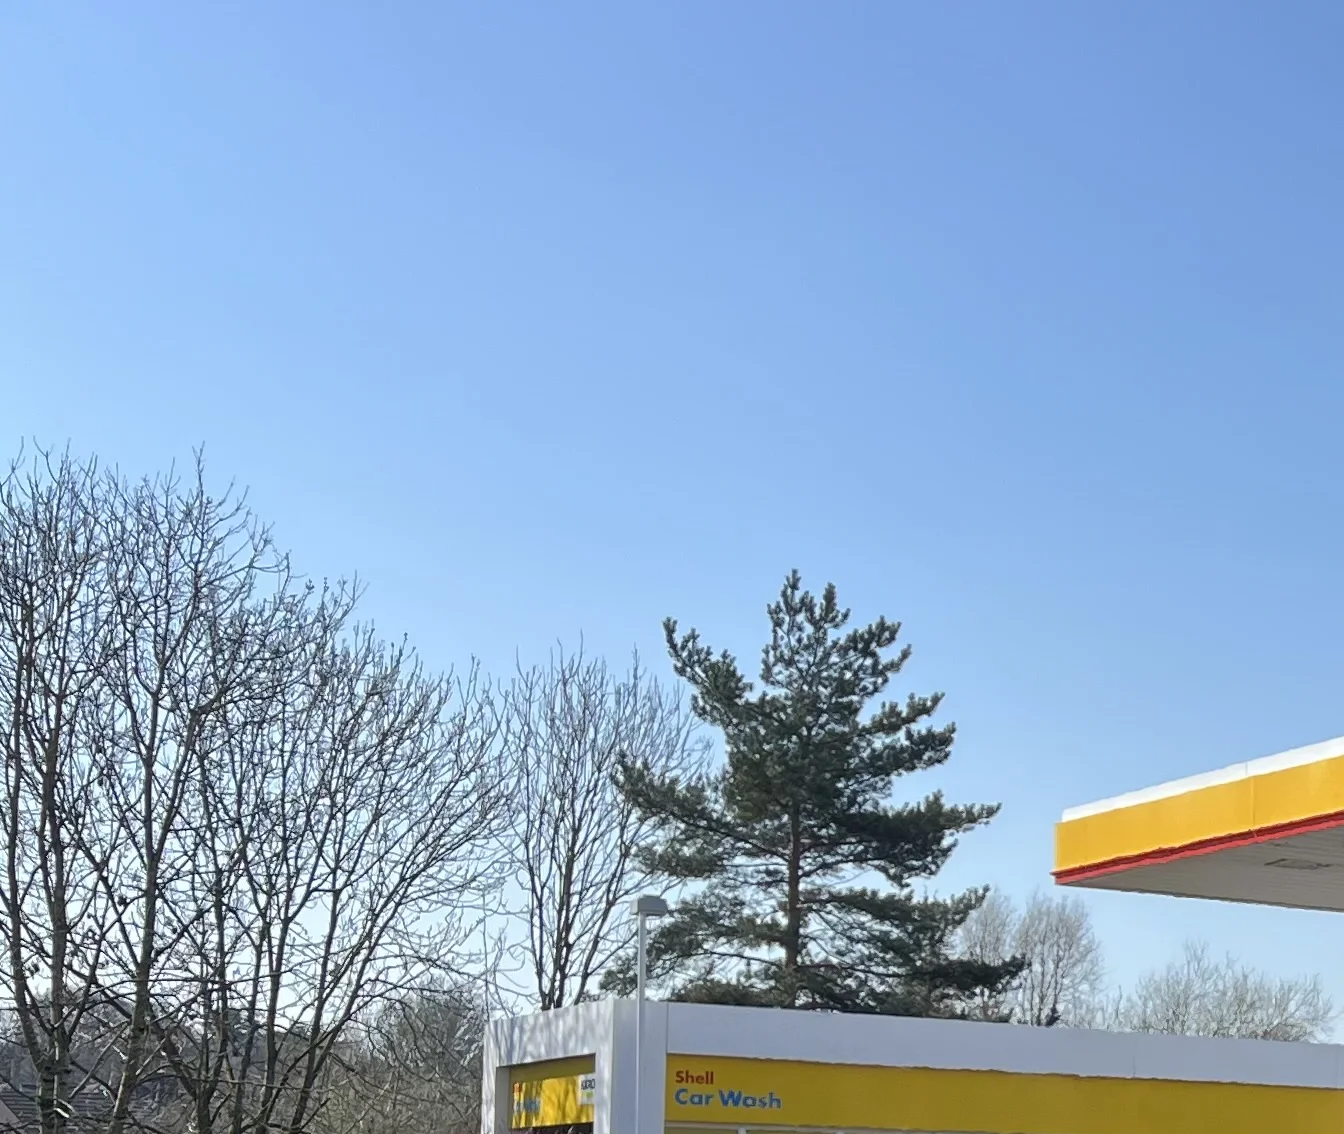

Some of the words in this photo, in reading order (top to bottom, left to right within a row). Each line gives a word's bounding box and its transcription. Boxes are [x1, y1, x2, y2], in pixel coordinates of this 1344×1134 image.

[675, 1069, 715, 1085] Shell
[674, 1088, 714, 1106] Car
[718, 1089, 782, 1109] Wash
